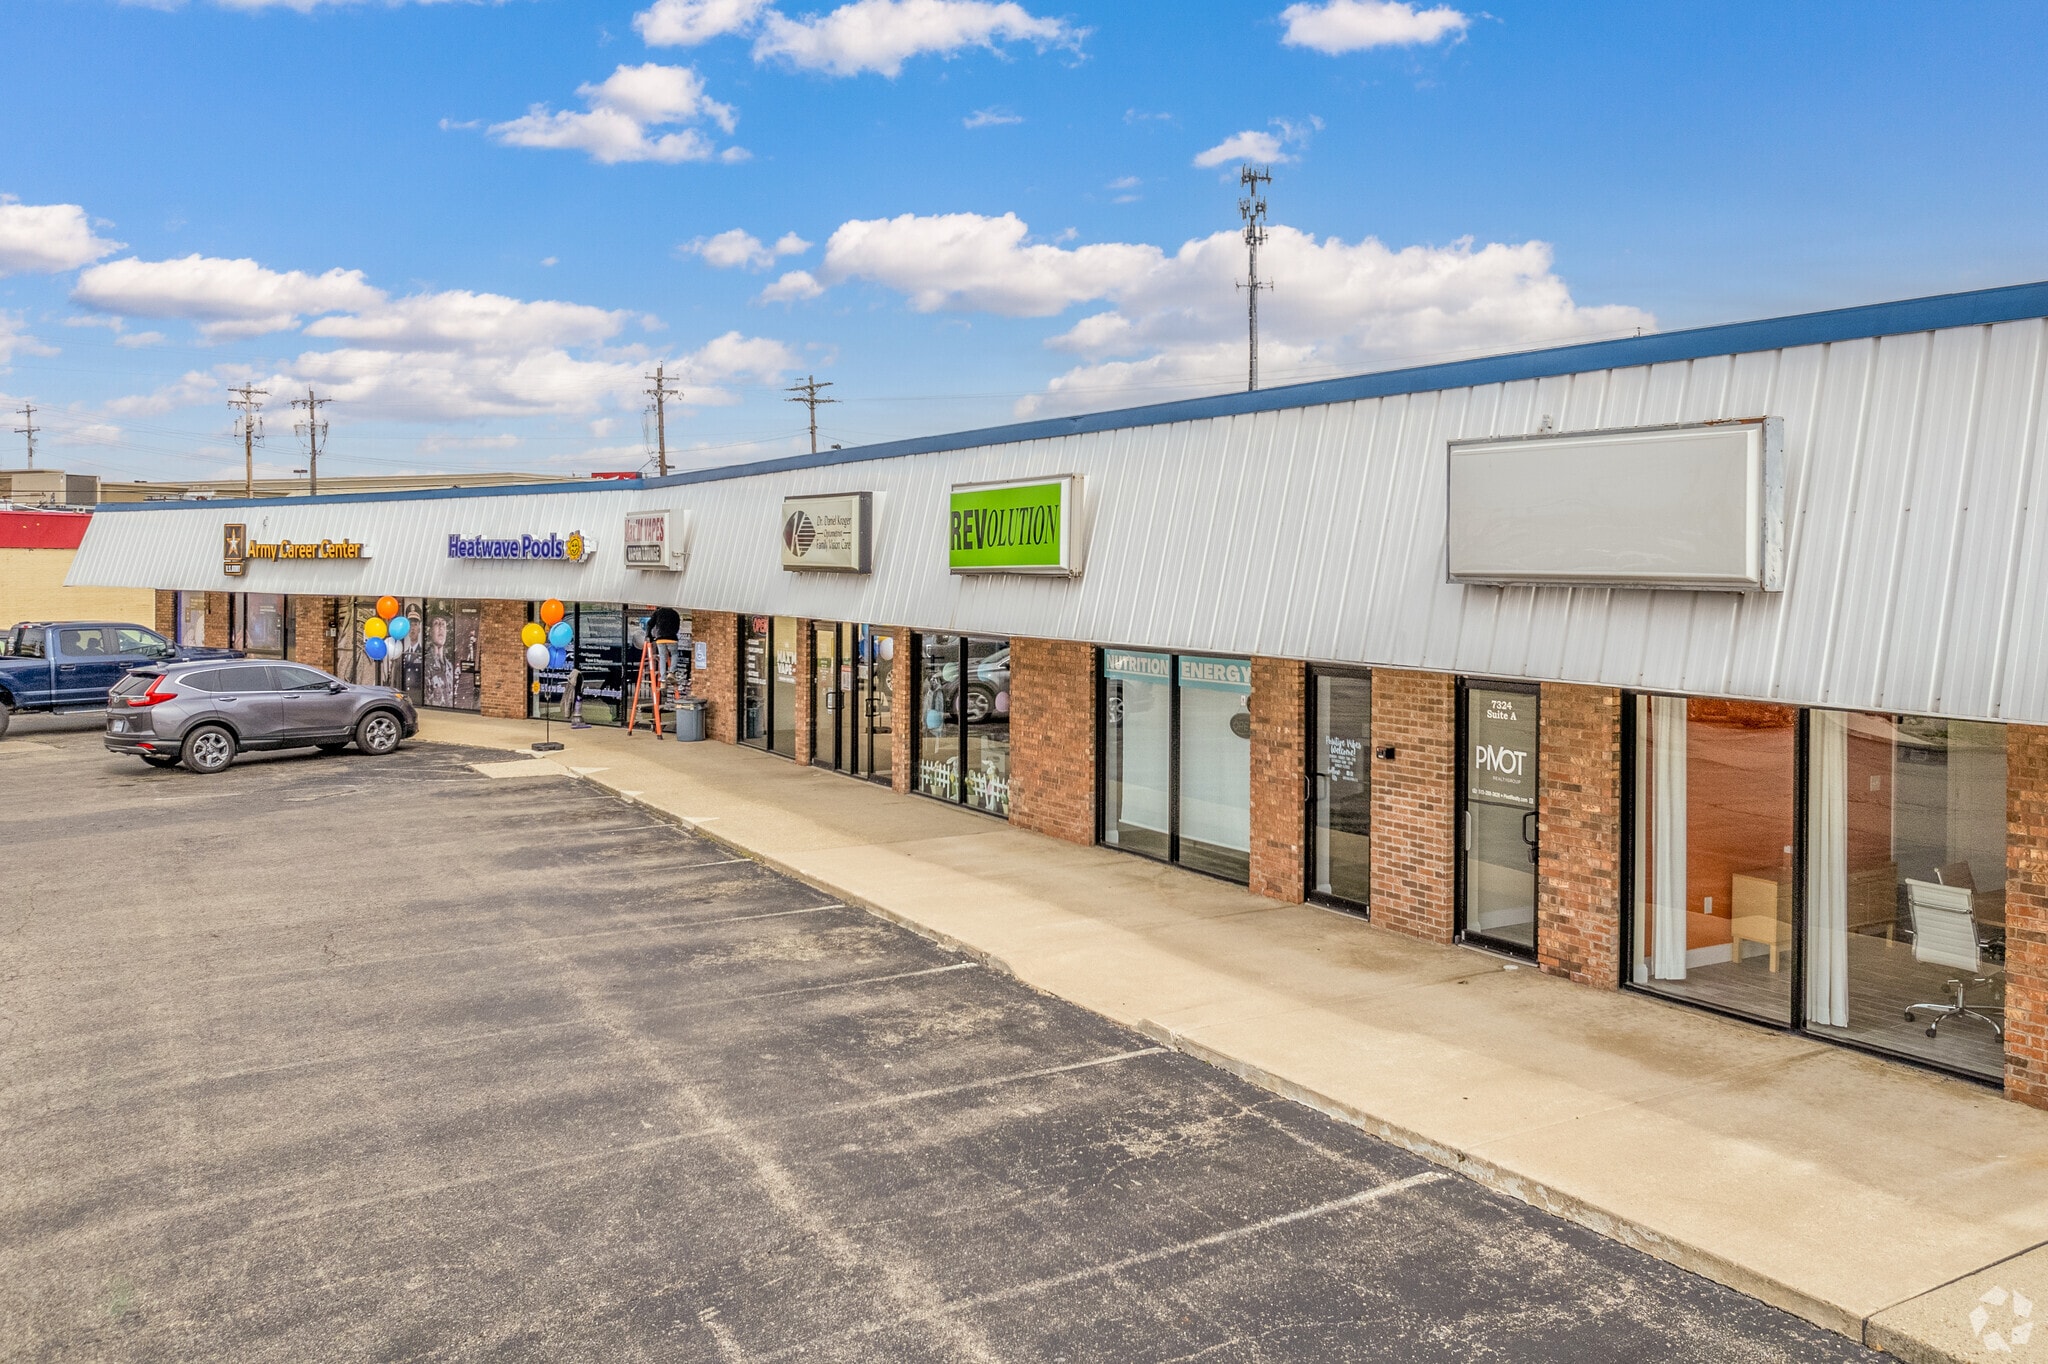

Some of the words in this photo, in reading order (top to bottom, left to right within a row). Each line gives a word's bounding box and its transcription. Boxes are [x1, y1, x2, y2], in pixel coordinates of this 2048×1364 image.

[645, 517, 665, 542] VAPES
[951, 505, 1059, 551] REVOLUTION
[247, 540, 279, 562] Army
[279, 539, 318, 559] Career
[319, 538, 361, 559] Center
[448, 534, 520, 559] Heatwave
[521, 532, 564, 559] Pools
[1106, 654, 1169, 676] NUTRITION
[1181, 661, 1251, 683] ENERGY
[1486, 709, 1509, 720] Suite
[1510, 711, 1517, 721] A
[1491, 700, 1513, 711] 7324
[1475, 744, 1528, 776] PIVOT
